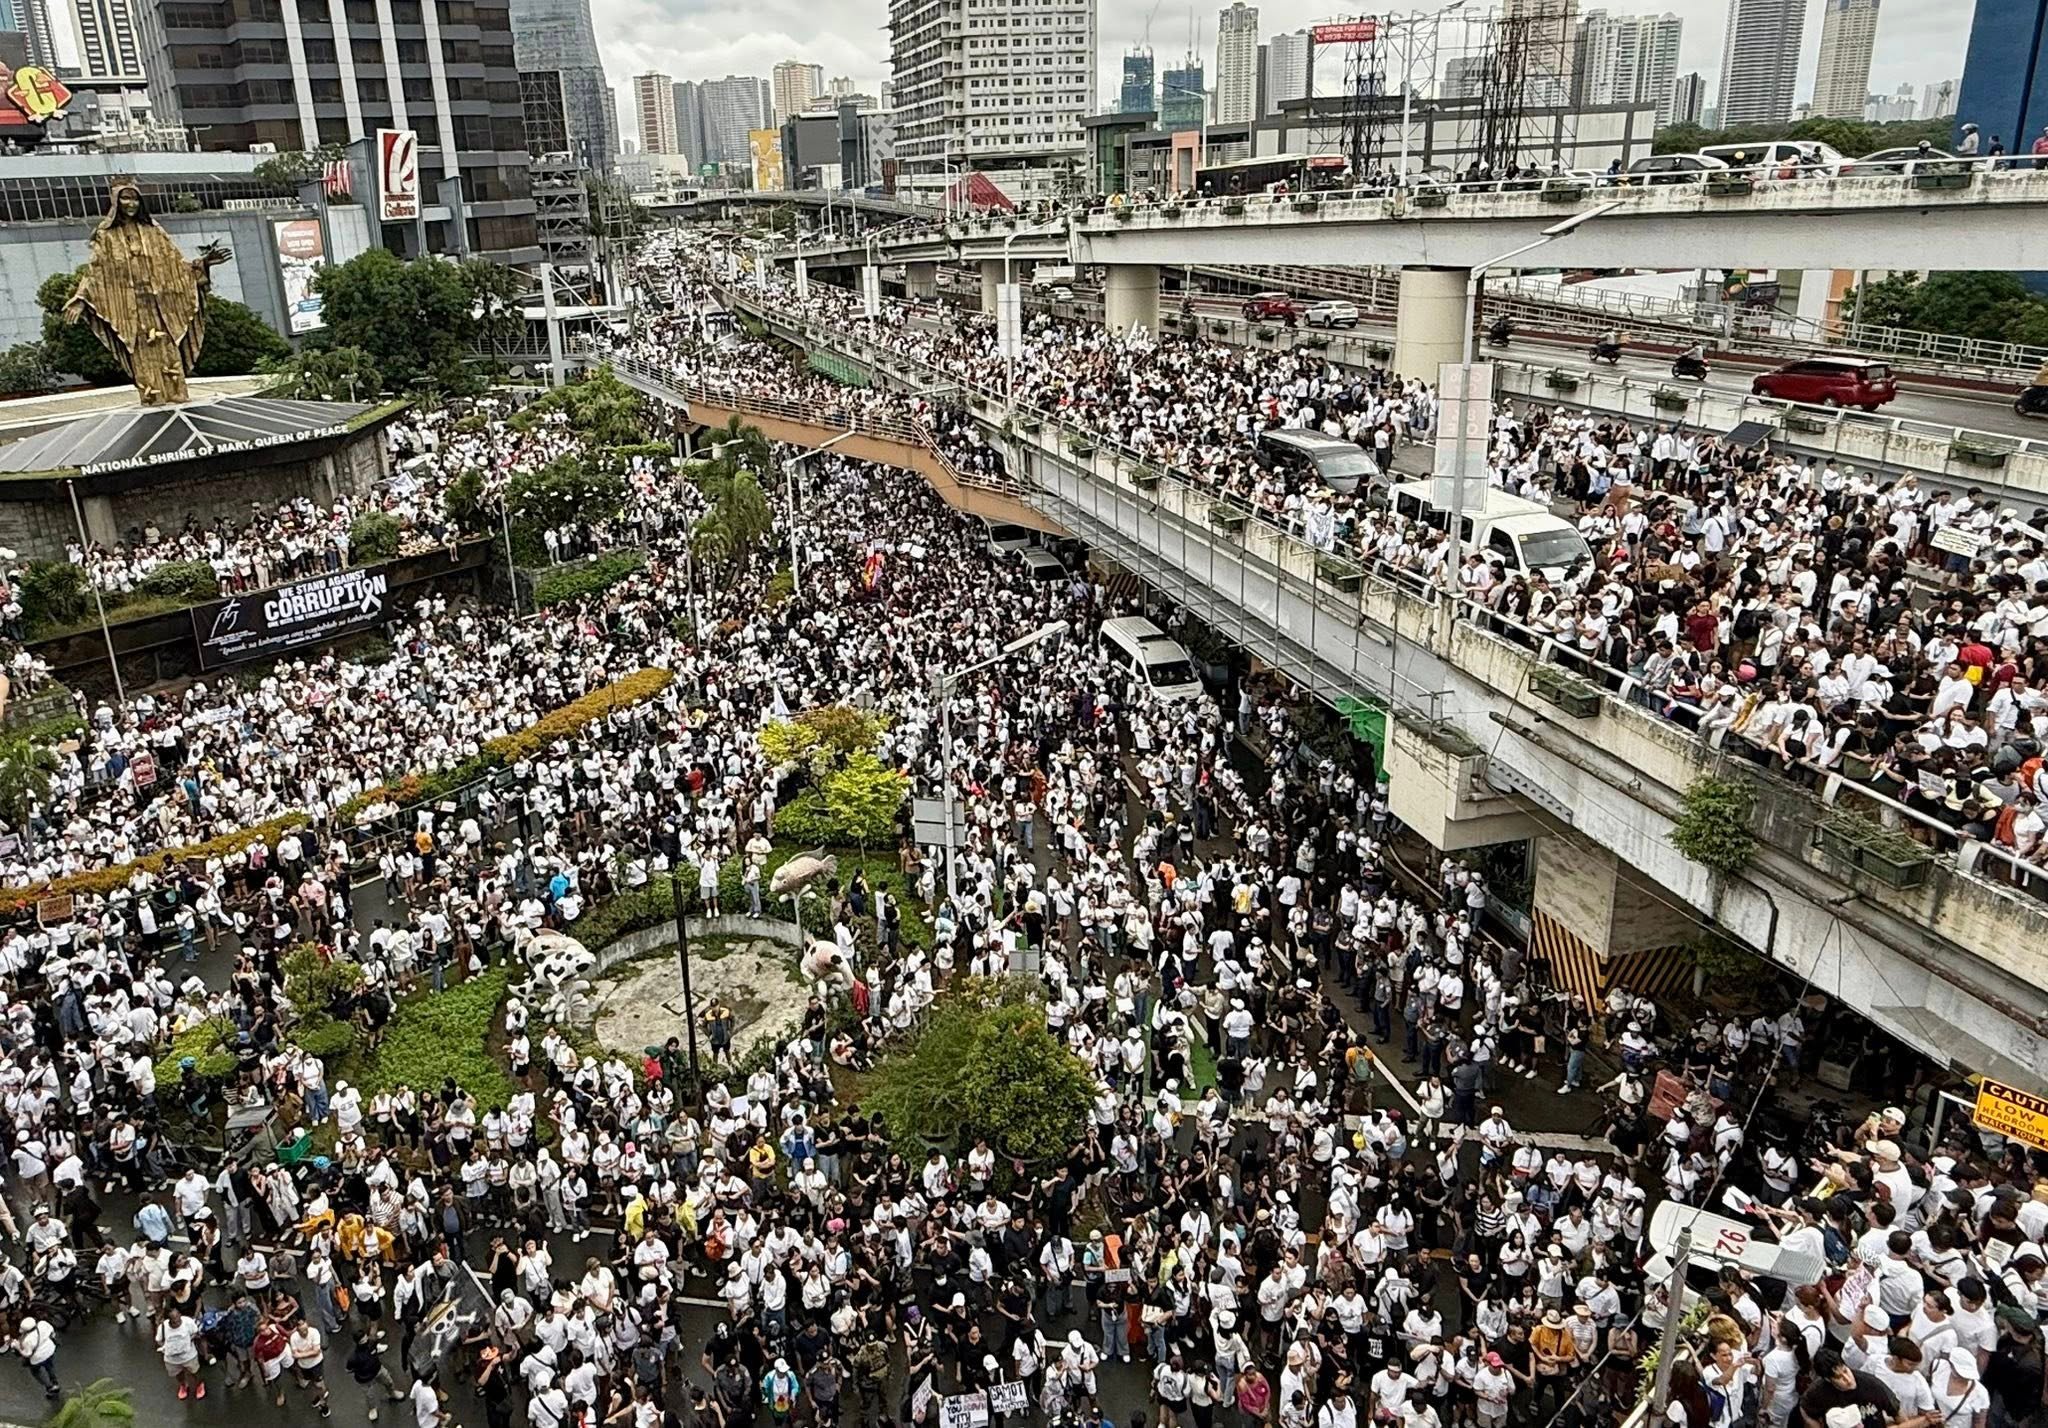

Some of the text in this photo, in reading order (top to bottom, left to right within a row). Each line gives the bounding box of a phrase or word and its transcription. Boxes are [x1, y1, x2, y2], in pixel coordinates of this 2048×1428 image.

[80, 424, 349, 475] NATIONAL SHRINE OF MARY, QUEEN OF PEACE
[278, 569, 367, 599] WE STAND AGAINST
[1990, 1085, 2048, 1114] CAUTI
[1994, 1101, 2036, 1122] LOW
[1979, 1115, 2012, 1132] WATCH
[2015, 1129, 2041, 1144] YOUR
[1982, 1106, 2044, 1136] HEADROOM
[1716, 1229, 1747, 1256] 92
[946, 1405, 962, 1414] YOU
[948, 1411, 971, 1423] WITH
